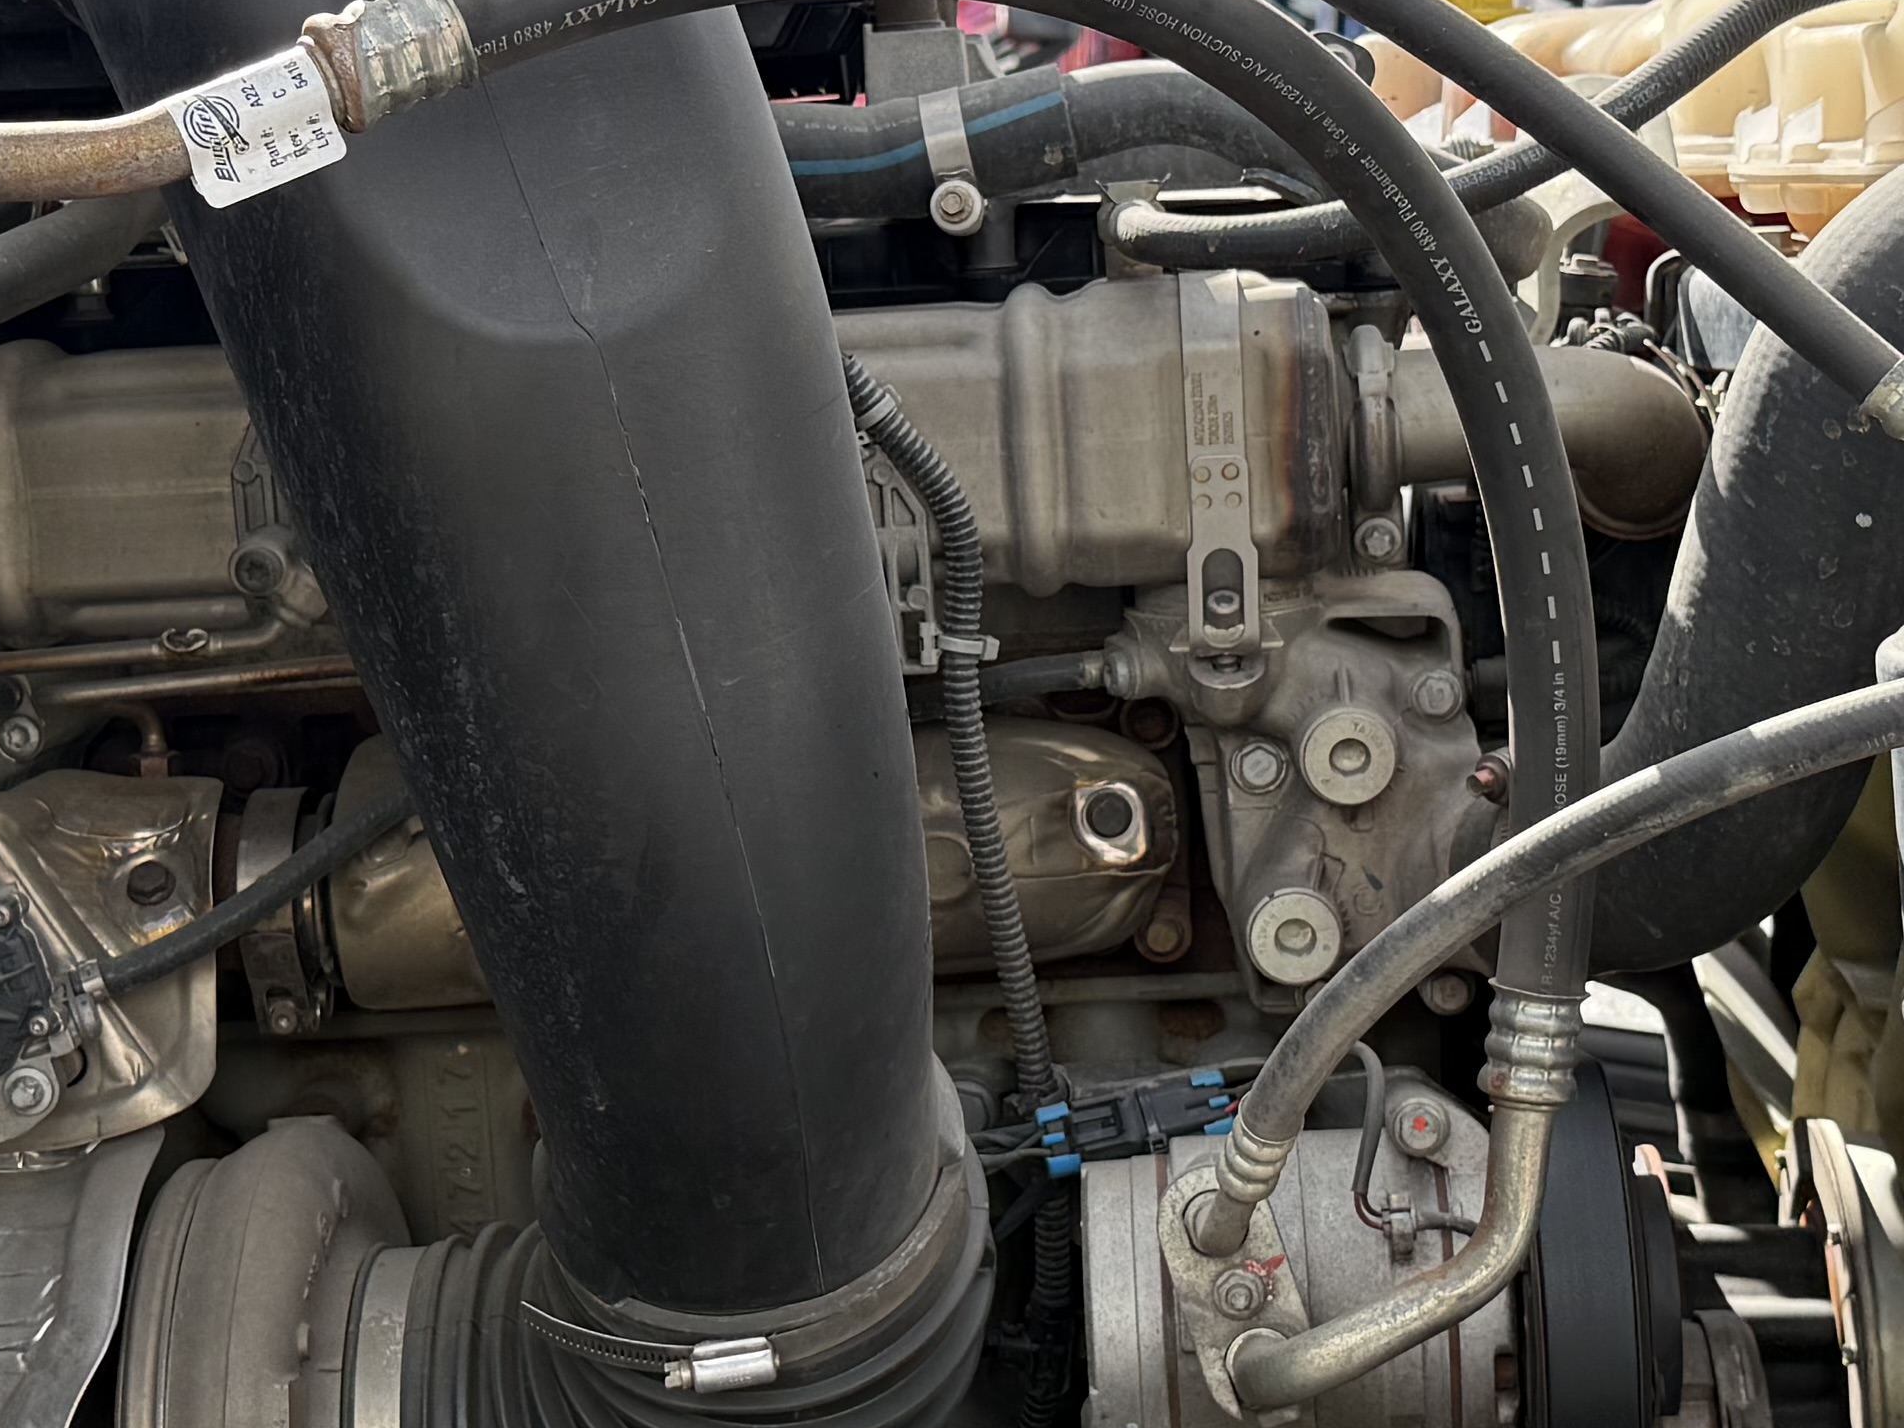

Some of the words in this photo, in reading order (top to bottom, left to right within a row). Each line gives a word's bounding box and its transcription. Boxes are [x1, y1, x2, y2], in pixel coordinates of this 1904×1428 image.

[1136, 4, 1180, 31] HOSE
[514, 20, 553, 46] 4880
[1178, 22, 1242, 63] SUCTION
[1240, 57, 1268, 78] A/C
[1408, 221, 1437, 252] 4880
[1429, 256, 1483, 334] GALAXY
[1553, 688, 1567, 712] 3/4
[1553, 715, 1570, 769] (19mm)
[1553, 773, 1567, 810] OSE
[1548, 892, 1563, 921] A/C
